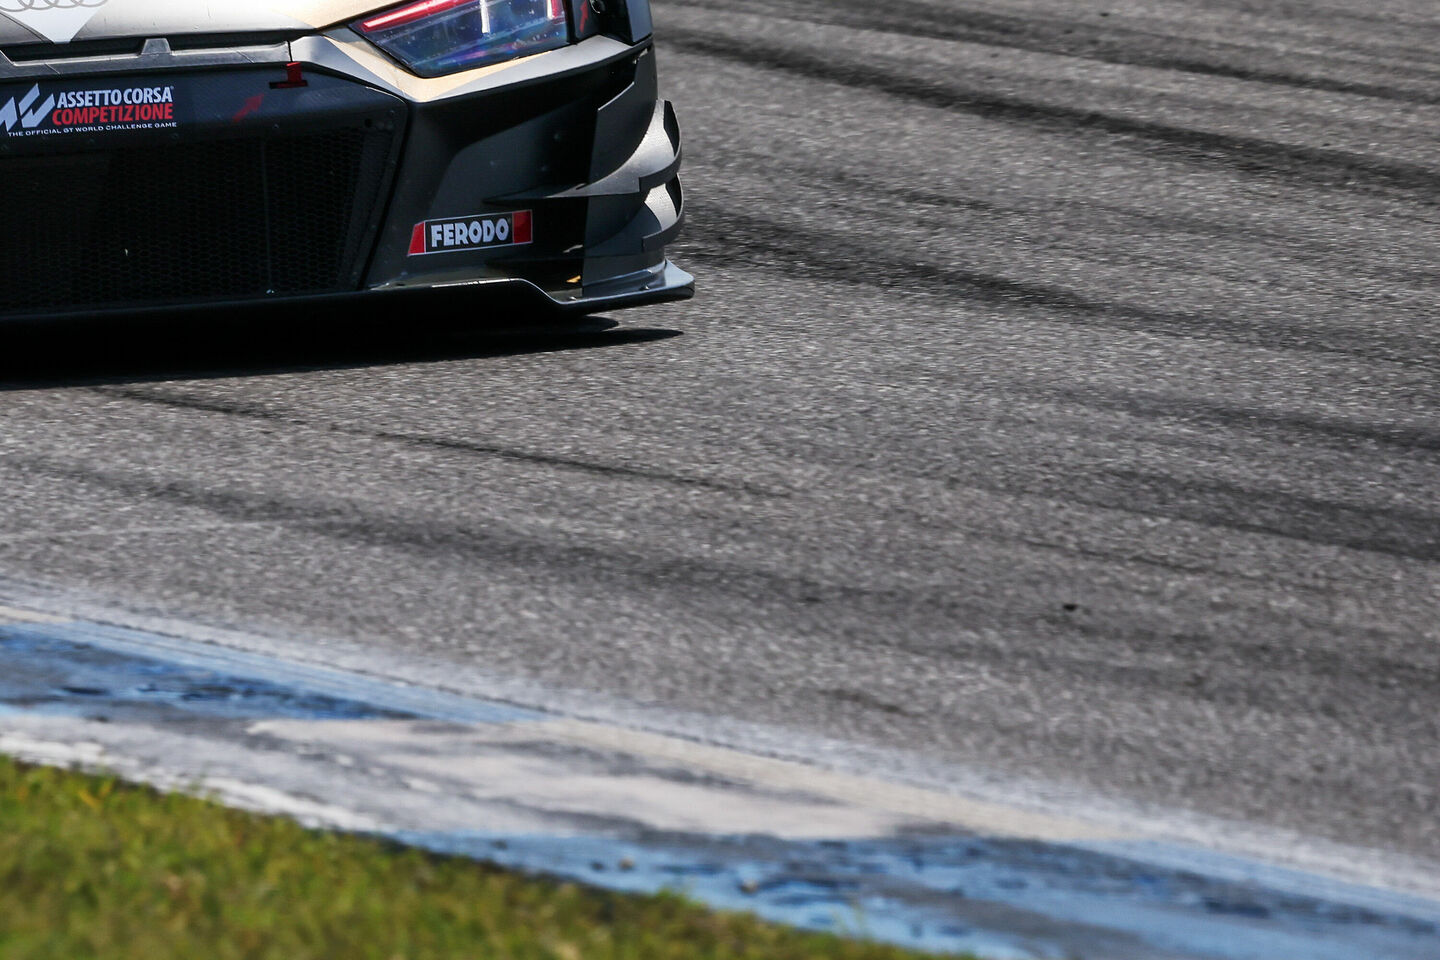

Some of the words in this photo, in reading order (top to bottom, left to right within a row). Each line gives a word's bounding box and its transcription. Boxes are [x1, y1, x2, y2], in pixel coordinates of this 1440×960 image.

[57, 89, 122, 108] ASSETTO
[123, 86, 173, 105] CORSA
[52, 103, 173, 126] COMPETIZIONE
[25, 128, 62, 137] OFFICIAL
[106, 123, 153, 131] CHALLENGE
[431, 218, 509, 247] FERODO
